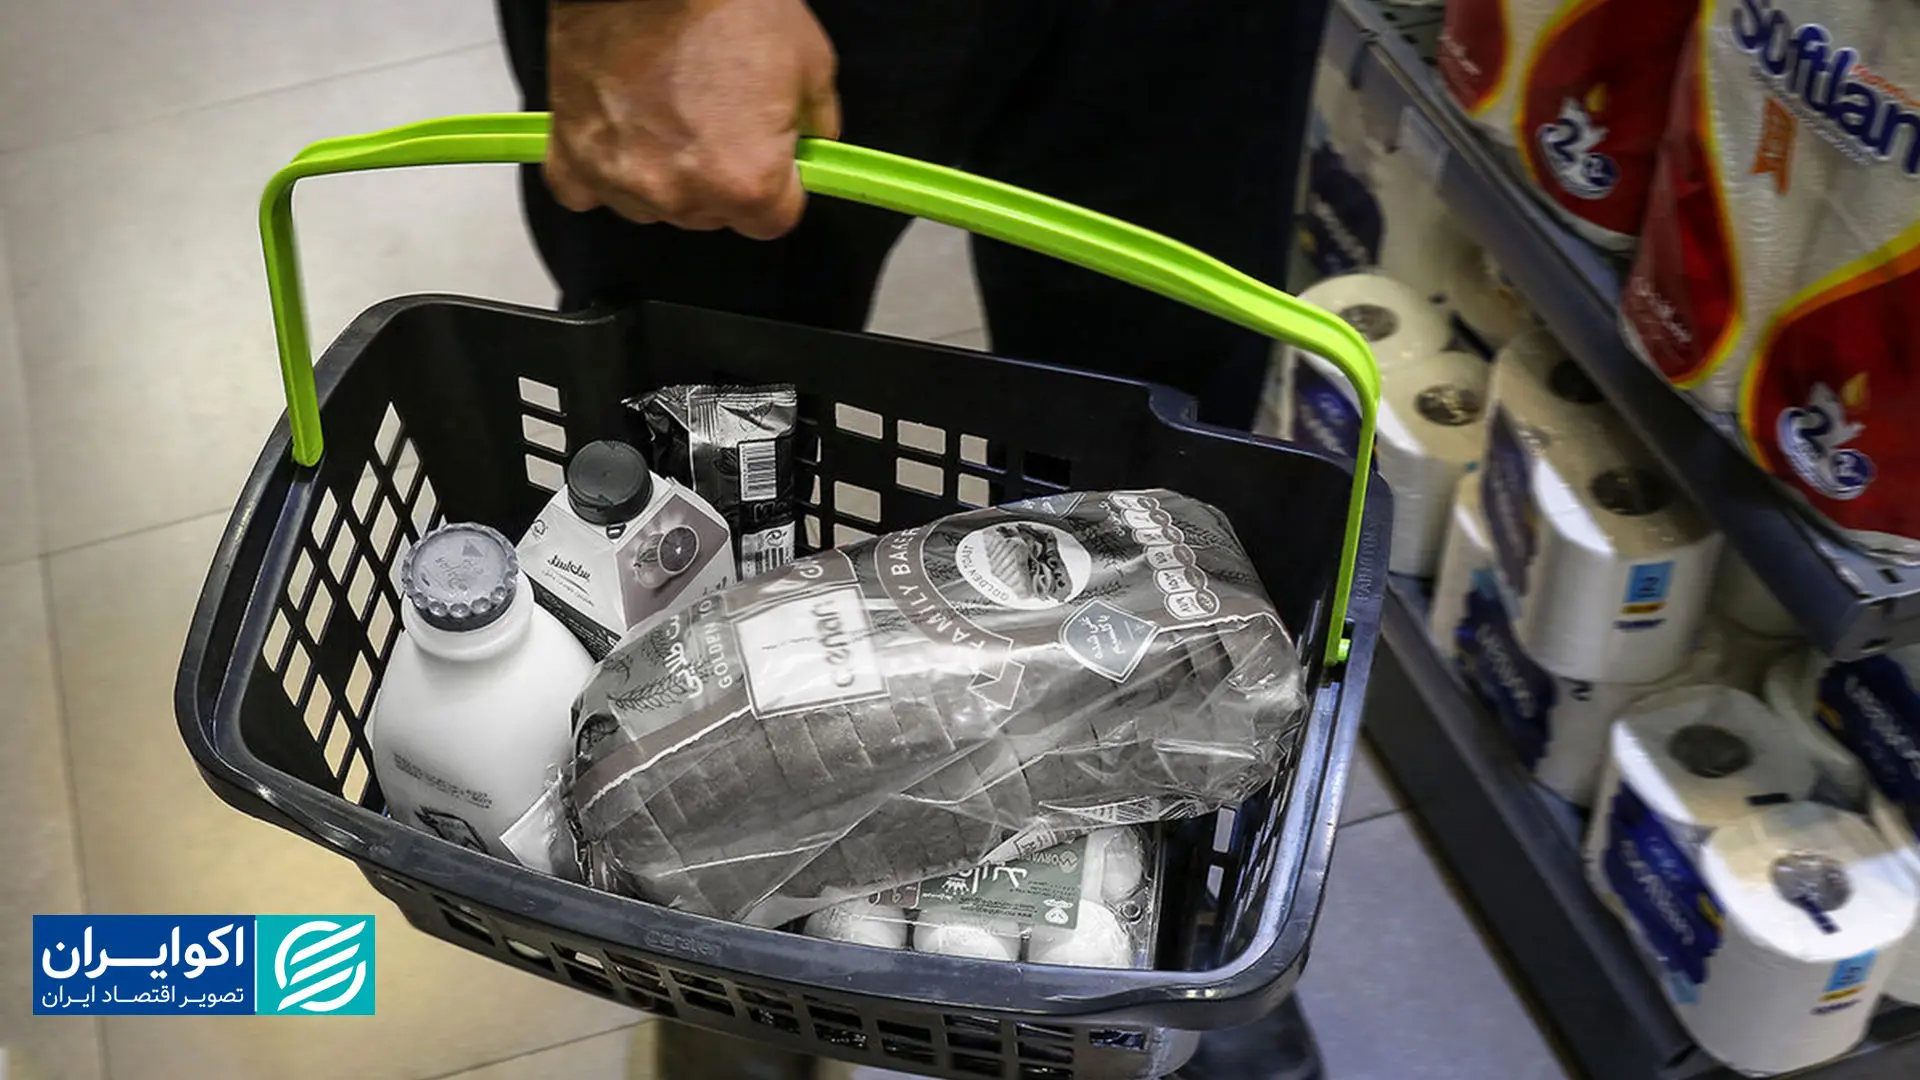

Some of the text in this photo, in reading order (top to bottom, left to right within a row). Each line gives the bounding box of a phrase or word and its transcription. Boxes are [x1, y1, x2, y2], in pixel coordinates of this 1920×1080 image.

[889, 527, 986, 649] FAMILY BAKER
[699, 600, 733, 688] GOLDEN TO
